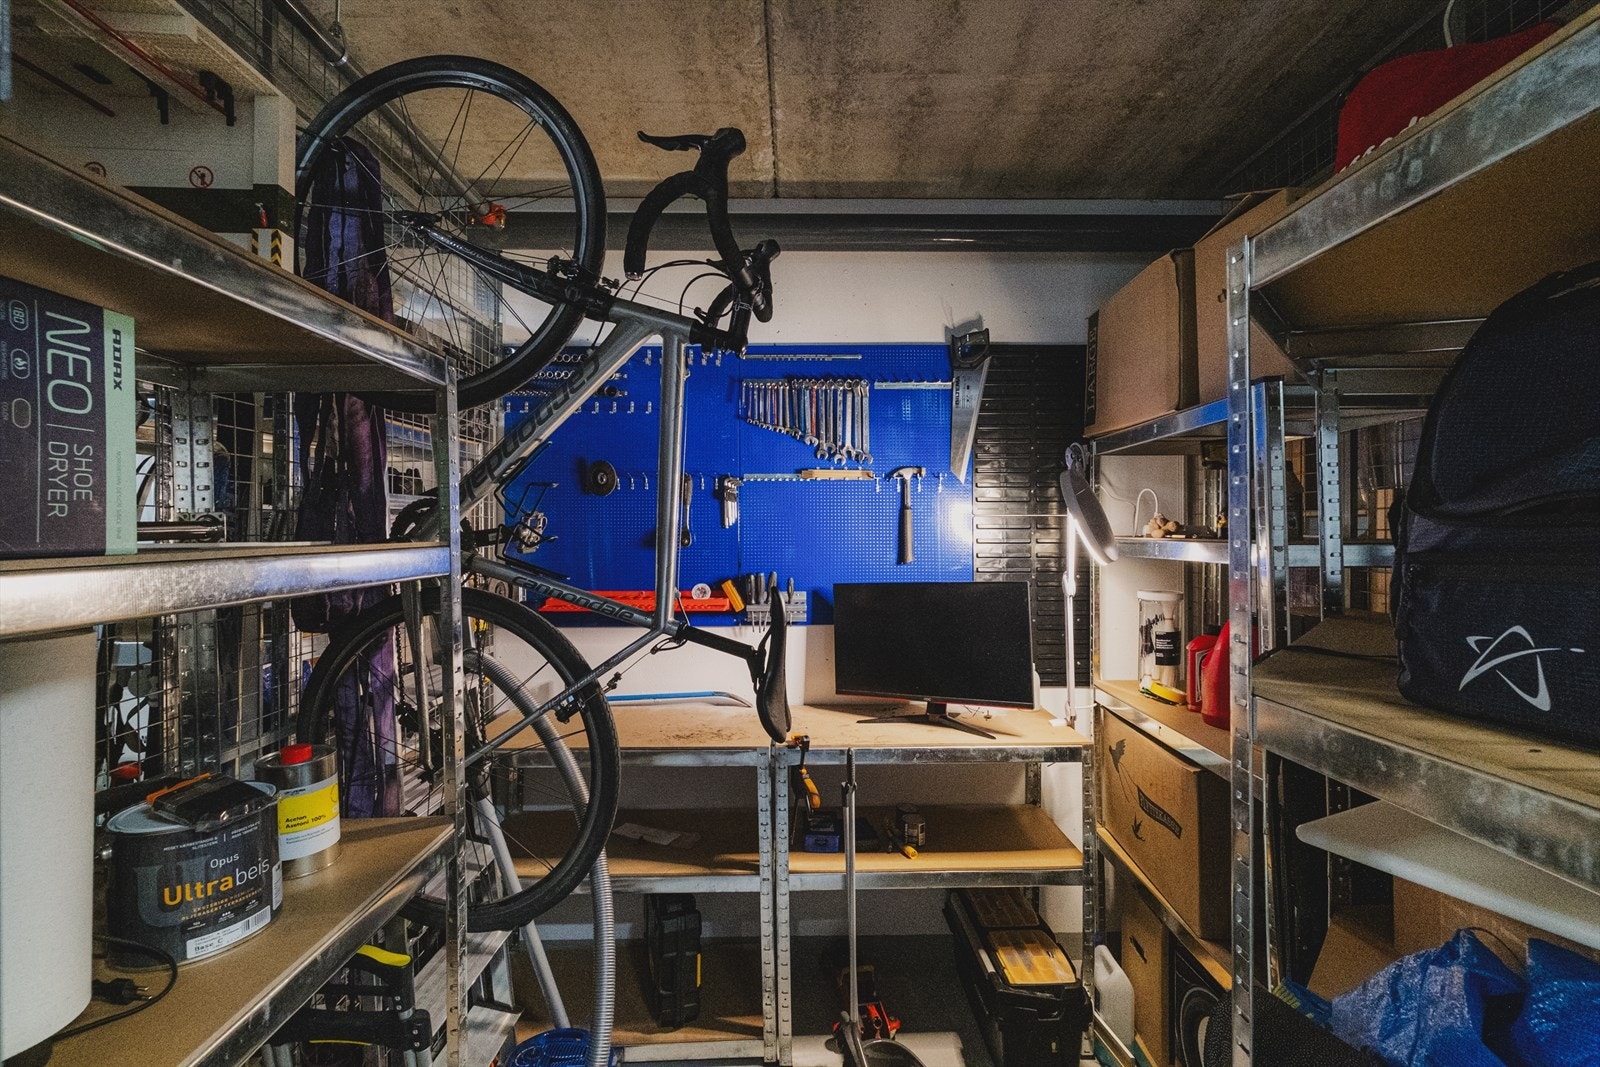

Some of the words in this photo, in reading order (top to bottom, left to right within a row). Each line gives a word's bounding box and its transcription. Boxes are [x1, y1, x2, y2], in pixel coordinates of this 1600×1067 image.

[45, 310, 93, 416] NEO
[112, 328, 123, 391] ADAX
[1087, 327, 1097, 411] LARGE
[47, 440, 69, 518] DRYER
[73, 443, 93, 502] SHOE
[513, 576, 635, 620] cannondale
[311, 814, 326, 823] 100%
[163, 857, 270, 906] Ultrabeis
[210, 853, 240, 869] Opus
[194, 942, 214, 954] Base
